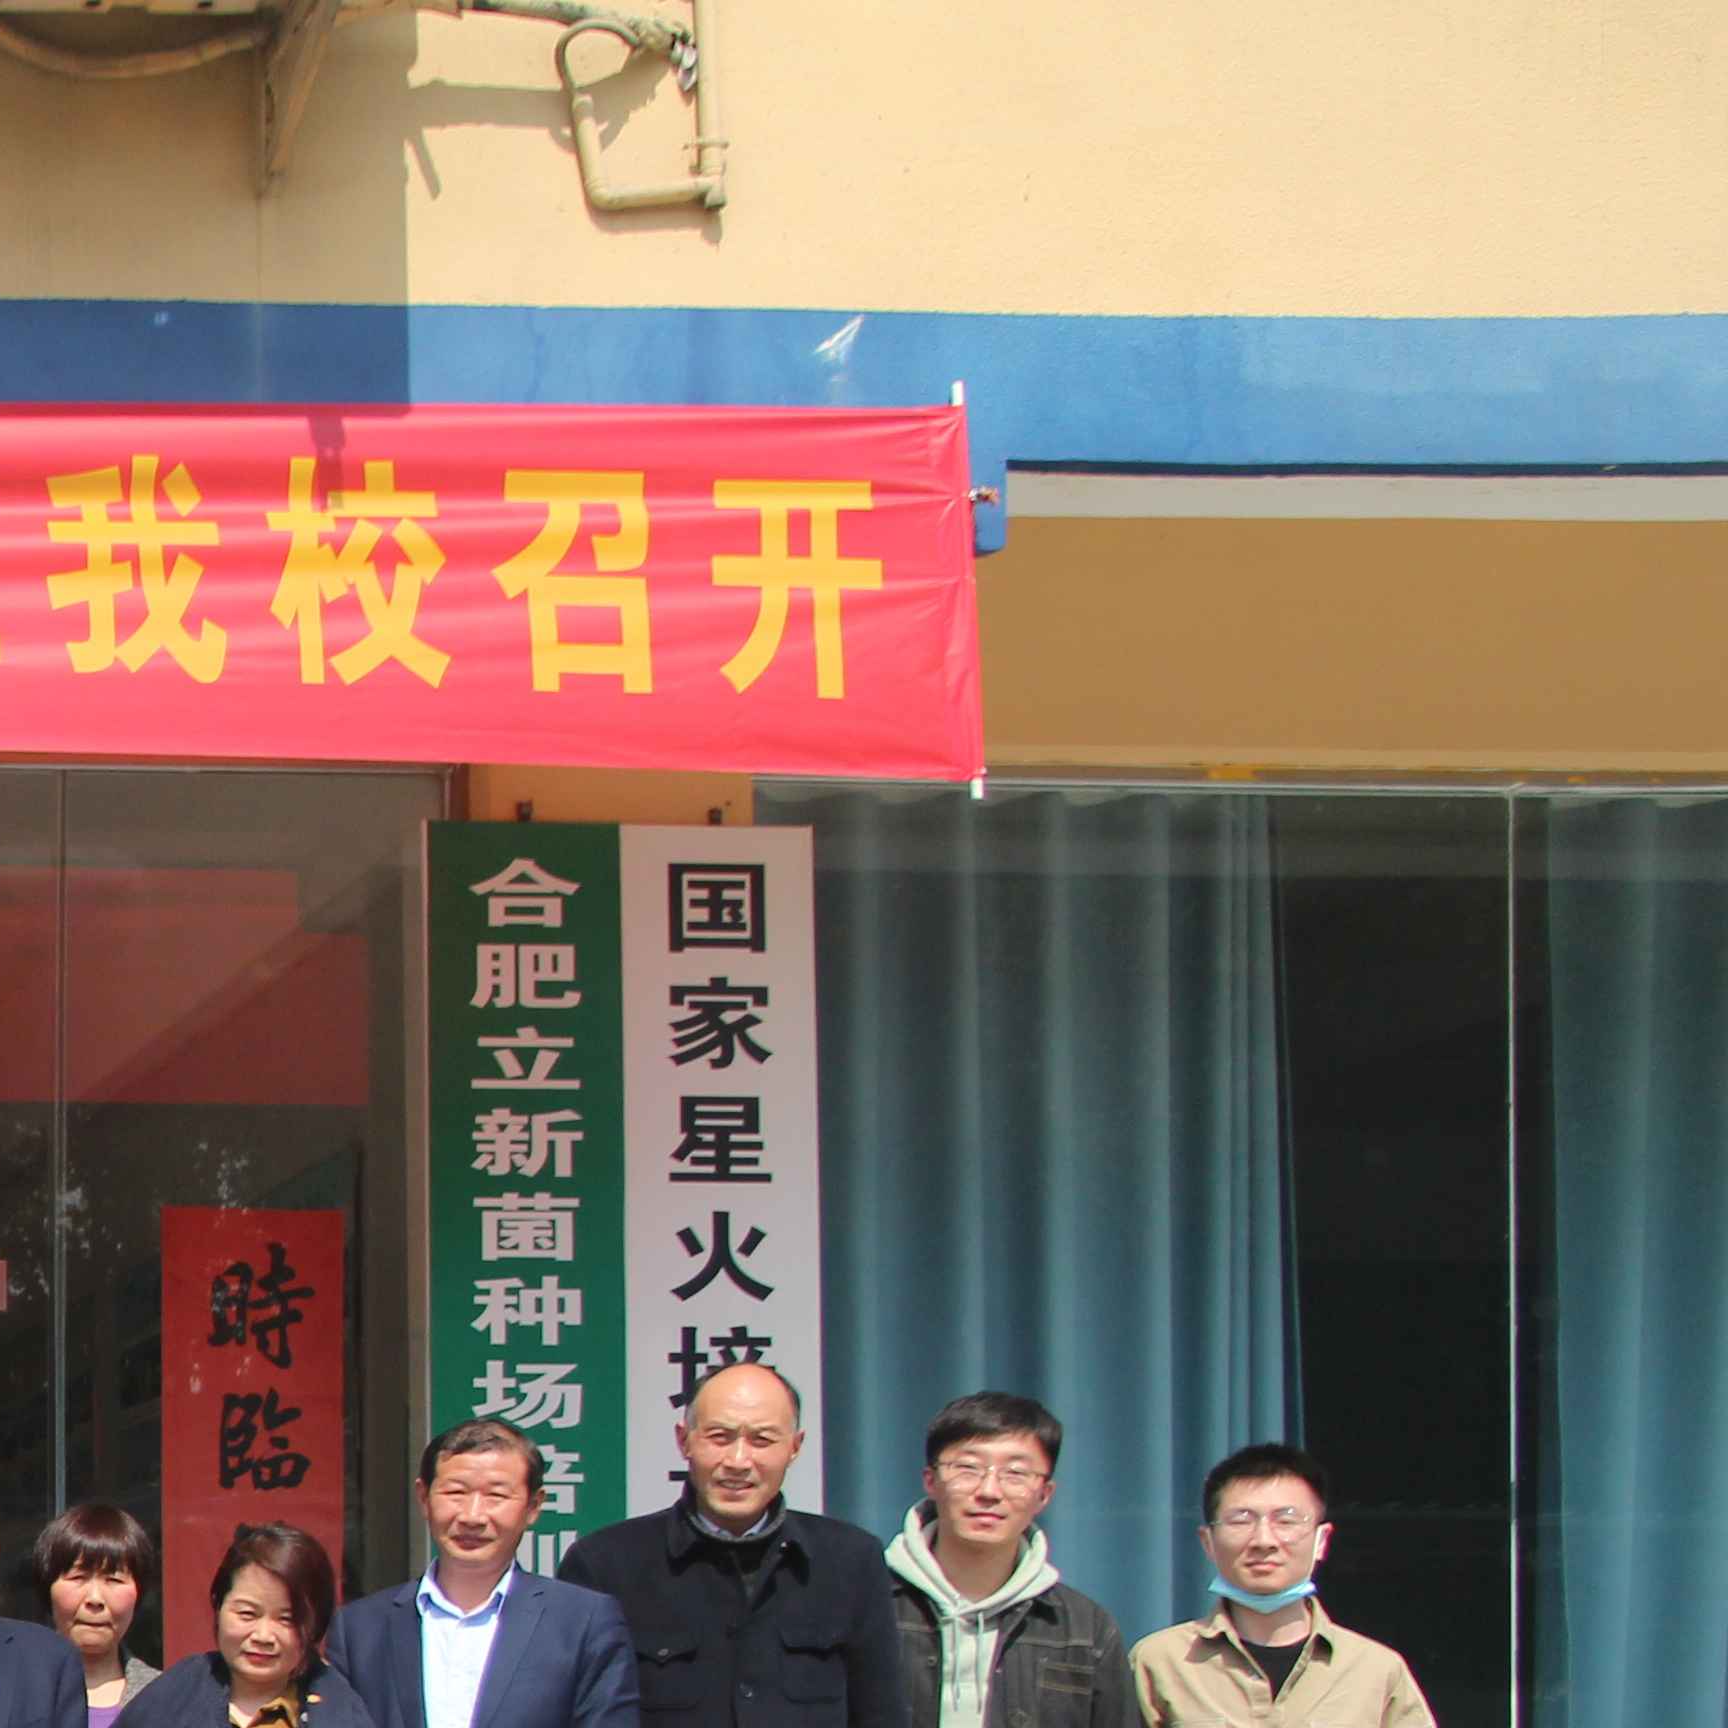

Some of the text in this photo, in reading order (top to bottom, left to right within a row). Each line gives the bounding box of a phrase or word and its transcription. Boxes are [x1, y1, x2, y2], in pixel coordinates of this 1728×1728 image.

[208, 1242, 316, 1534] 時臨
[668, 862, 774, 1500] 国家星火培
